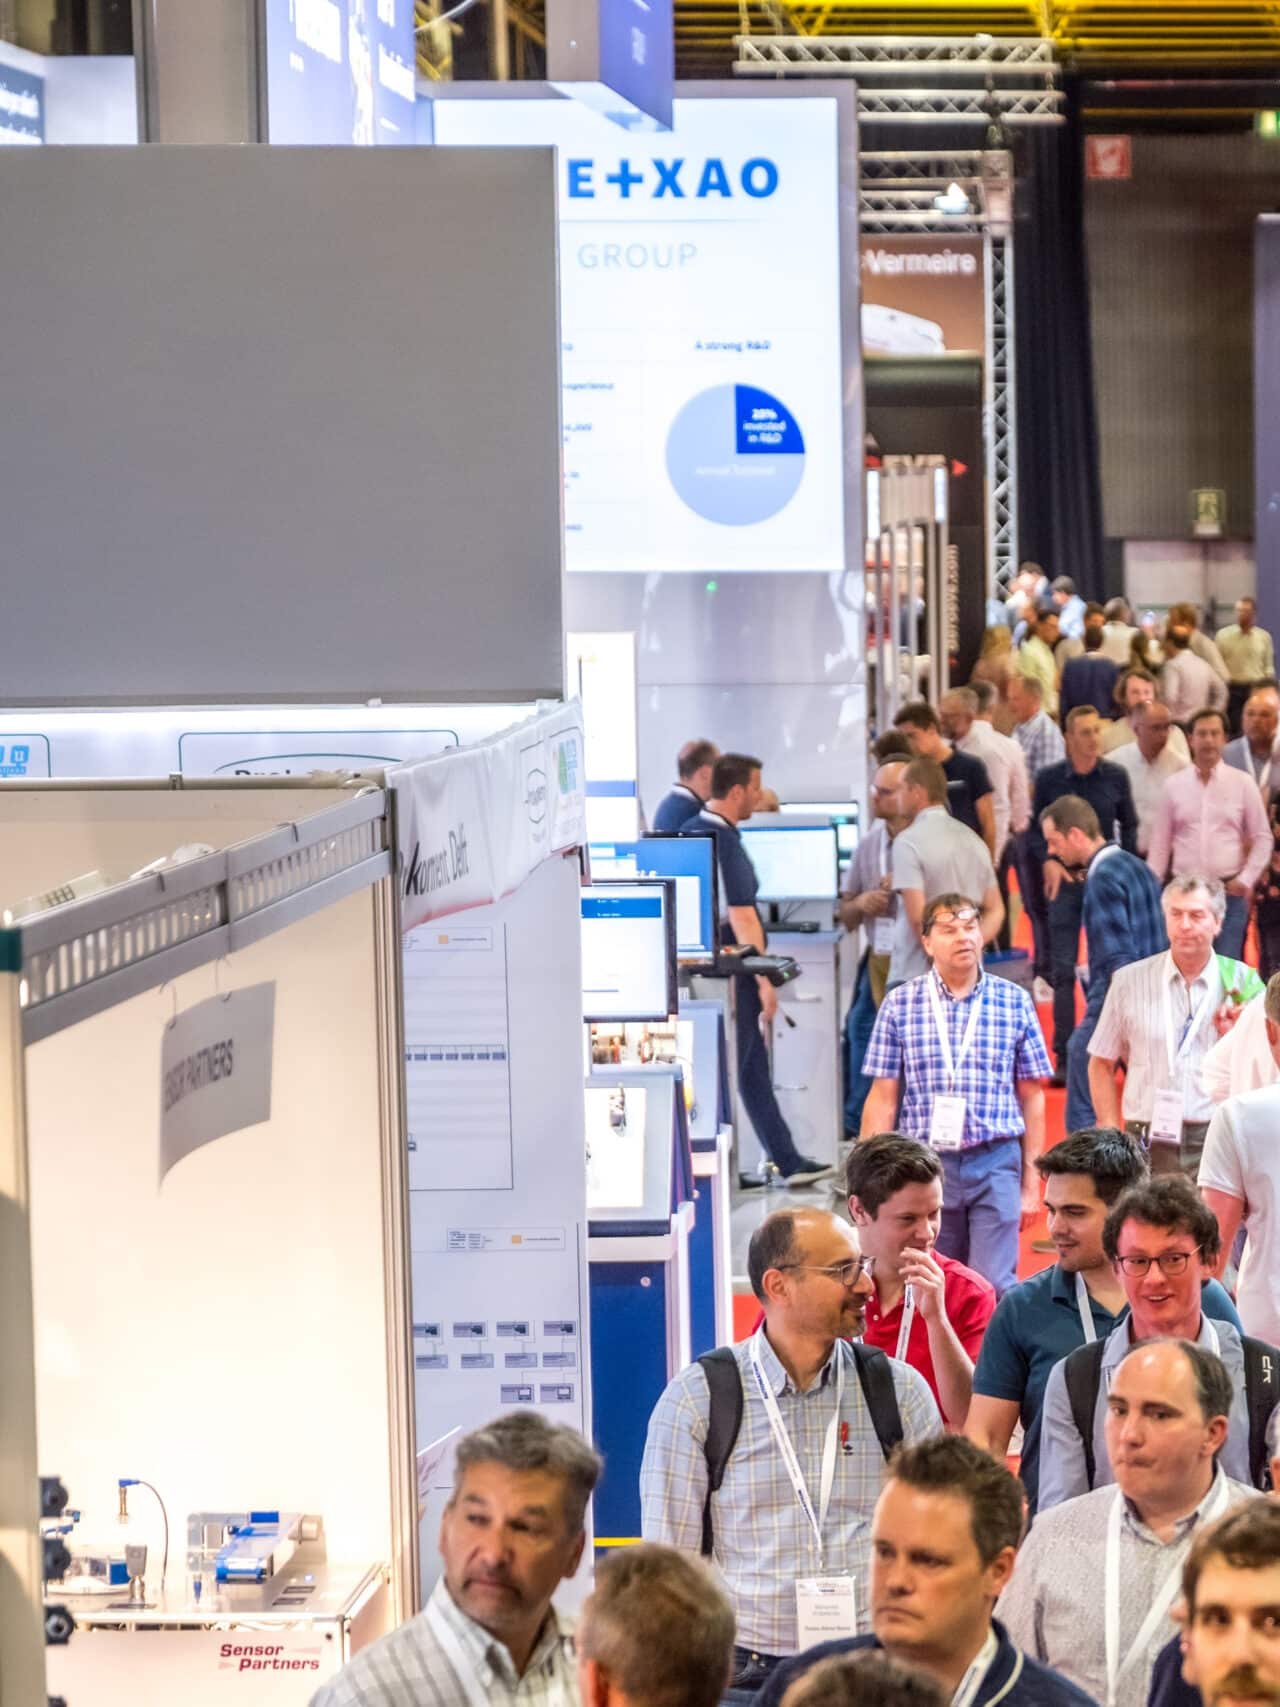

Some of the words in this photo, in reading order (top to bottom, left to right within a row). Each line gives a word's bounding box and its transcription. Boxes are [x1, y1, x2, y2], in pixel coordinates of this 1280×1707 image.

[567, 157, 777, 198] E+XAO
[577, 242, 699, 269] GROUP
[865, 249, 977, 275] Vermeire
[219, 1643, 284, 1658] Sensor
[239, 1657, 320, 1672] Partners
